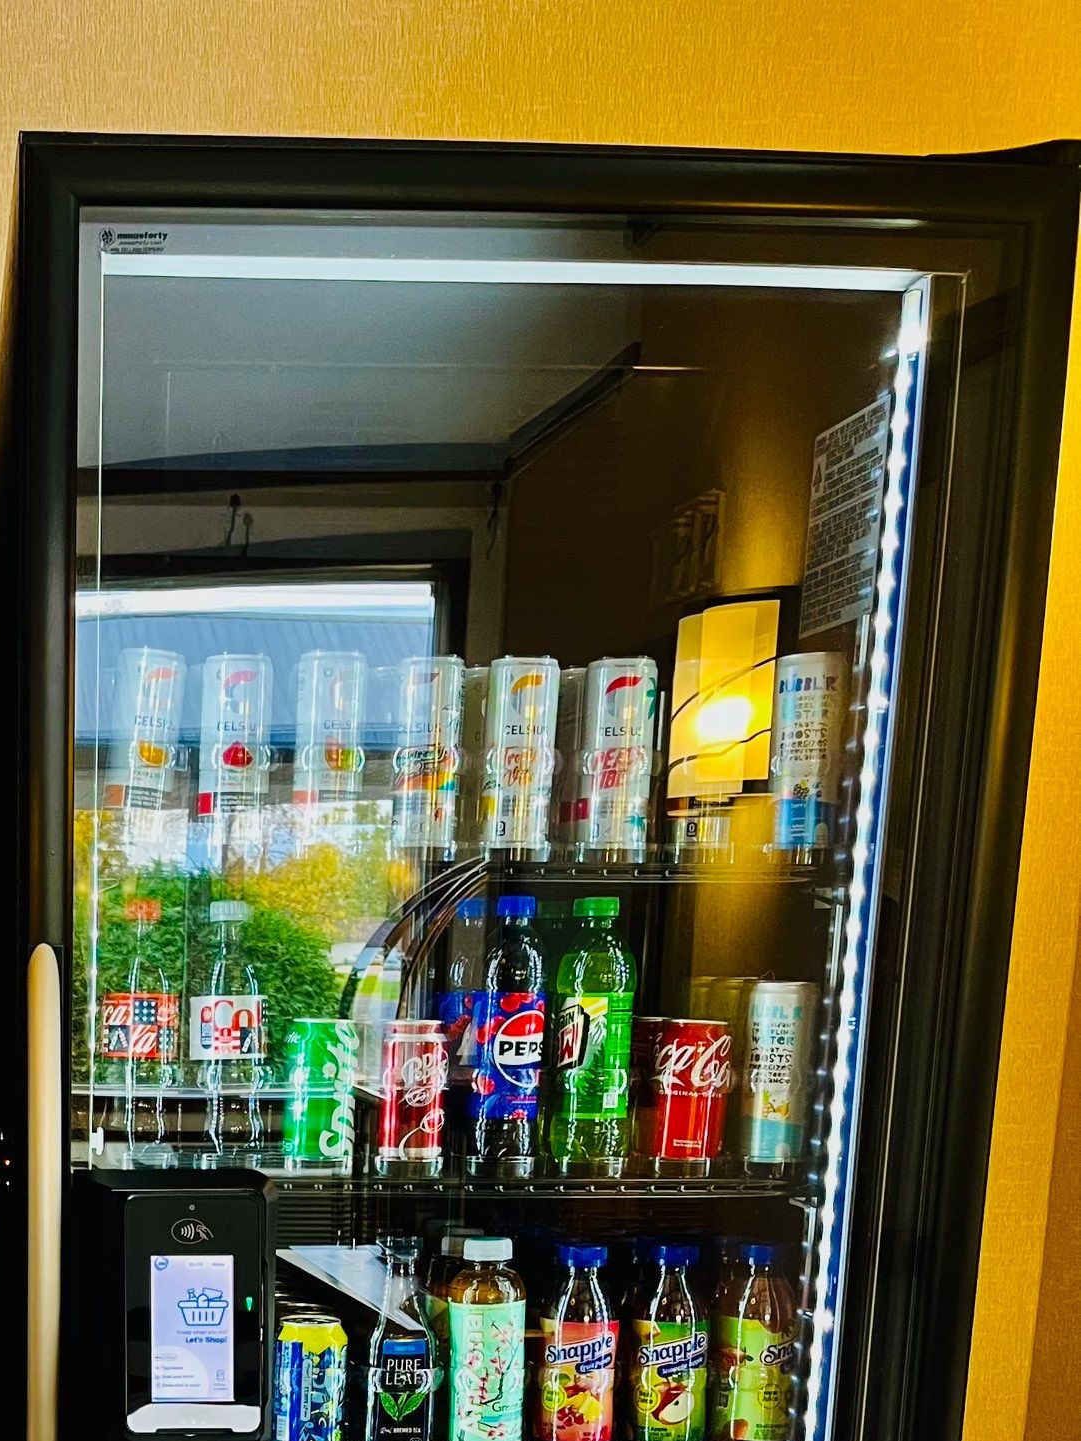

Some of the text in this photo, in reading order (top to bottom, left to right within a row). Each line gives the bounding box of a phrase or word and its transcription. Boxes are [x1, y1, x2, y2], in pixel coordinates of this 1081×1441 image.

[217, 720, 257, 733] CELSIU
[504, 724, 543, 736] CELSIU
[498, 1040, 543, 1057] PEPS
[547, 1334, 613, 1365] Snapple
[639, 1334, 707, 1366] Snapple
[386, 1358, 422, 1372] PURE
[385, 1372, 423, 1386] LEAF
